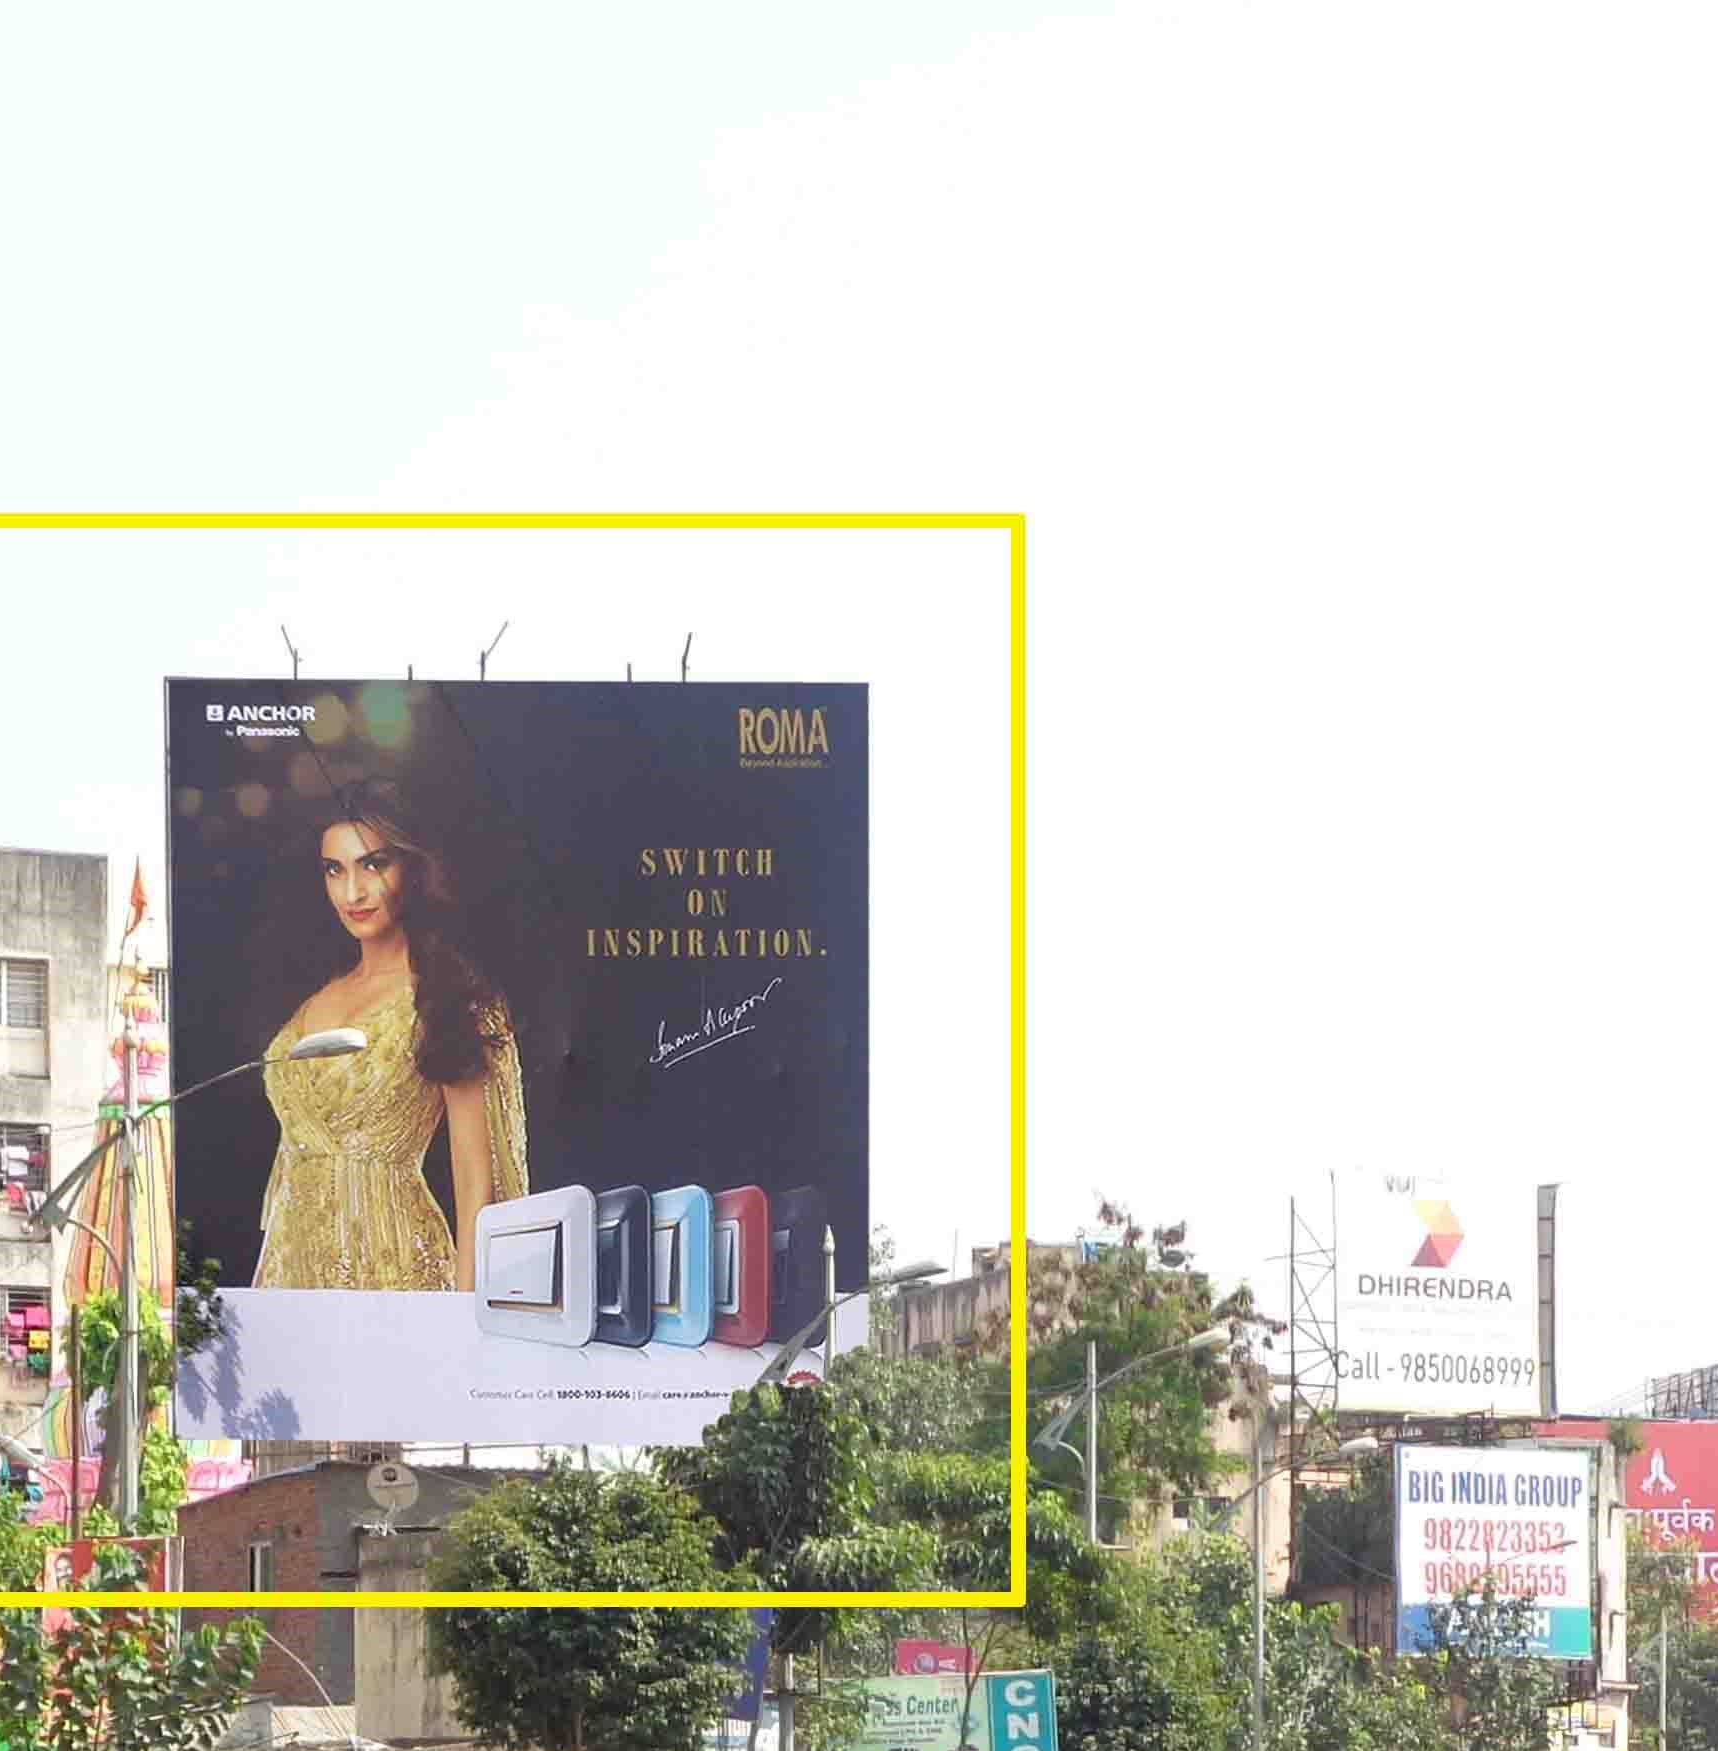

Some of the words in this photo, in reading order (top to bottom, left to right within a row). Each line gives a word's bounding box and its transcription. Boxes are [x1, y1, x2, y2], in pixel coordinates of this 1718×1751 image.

[226, 704, 316, 721] ANCHOR
[236, 725, 300, 737] Panasonic
[739, 707, 829, 754] ROMA
[640, 847, 773, 877] SWITCH
[687, 888, 727, 917] ON
[586, 927, 828, 958] INSPIRATION.
[1358, 1273, 1513, 1302] DHIRENDRA
[1334, 1349, 1380, 1381] Call
[1400, 1352, 1536, 1387] 9850068999
[1407, 1470, 1444, 1504] BIG
[1451, 1471, 1508, 1505] INDIA
[1514, 1473, 1583, 1509] GROUP
[906, 1695, 957, 1715] Center
